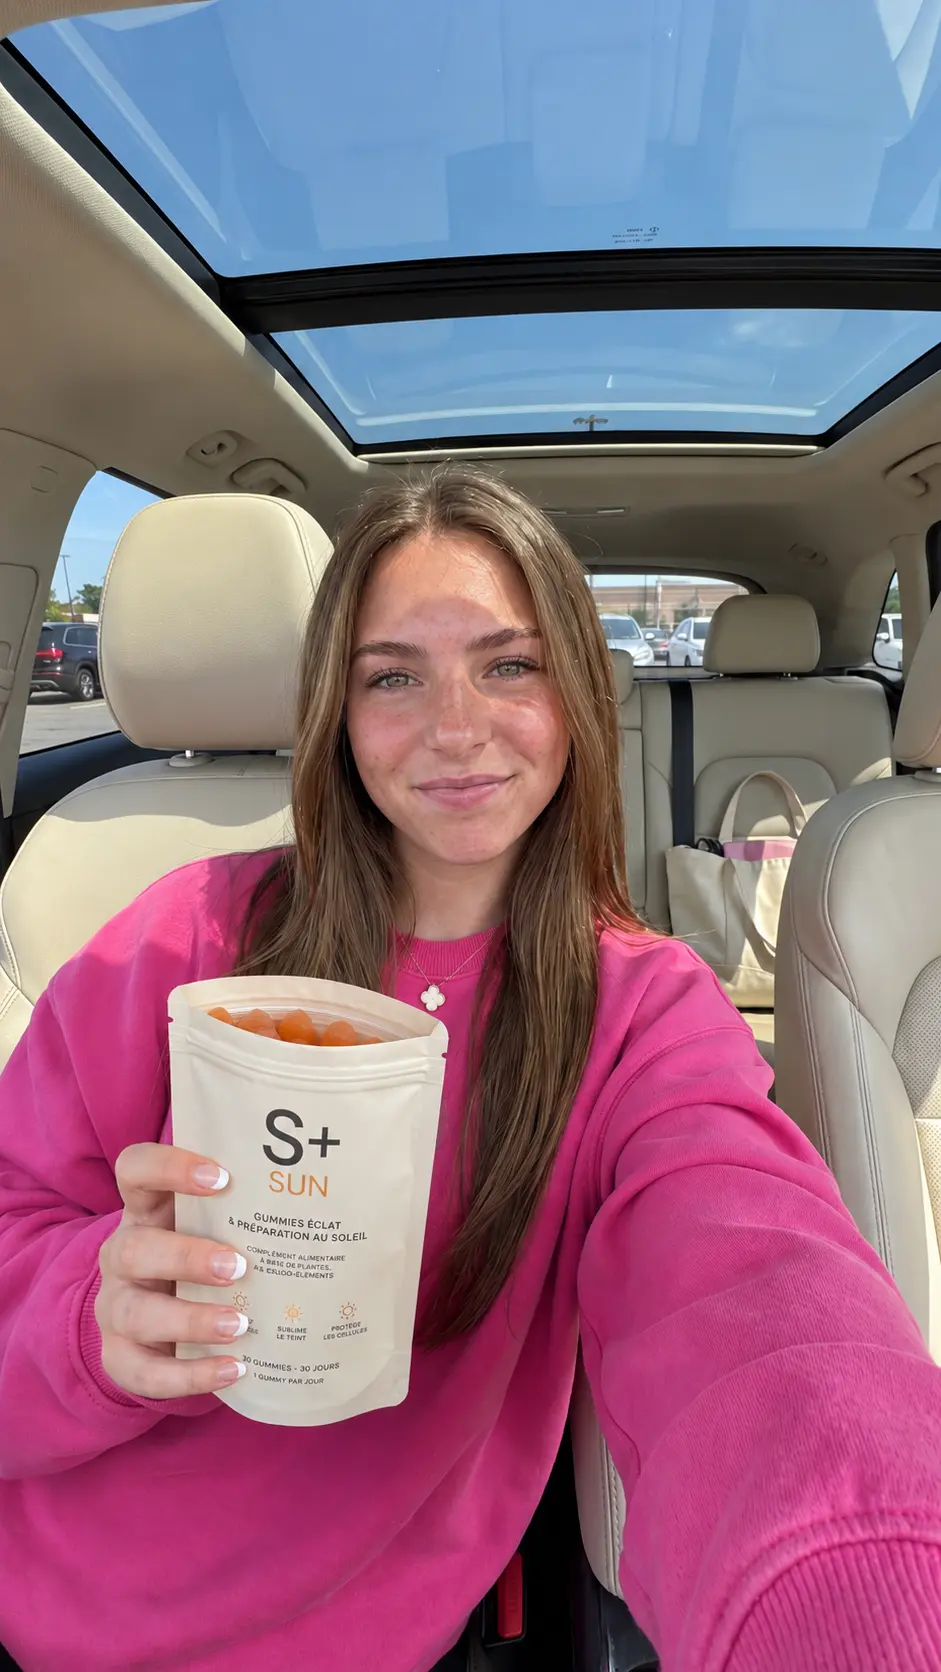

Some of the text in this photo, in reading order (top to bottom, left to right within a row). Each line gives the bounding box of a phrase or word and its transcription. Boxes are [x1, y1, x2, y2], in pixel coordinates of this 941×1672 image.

[262, 1108, 340, 1166] S+
[268, 1170, 328, 1198] SUN
[253, 1212, 342, 1230] GUMMIES ÉCLAT
[228, 1216, 367, 1242] & PRÉPARATION AU SOLEIL
[298, 1254, 346, 1262] ALIMENTAIRE
[277, 1325, 307, 1334] SUBLIME
[337, 1326, 368, 1338] CELLULES
[253, 1359, 292, 1372] GUMMIES
[313, 1362, 340, 1372] JOURS
[258, 1373, 287, 1383] GUMMY
